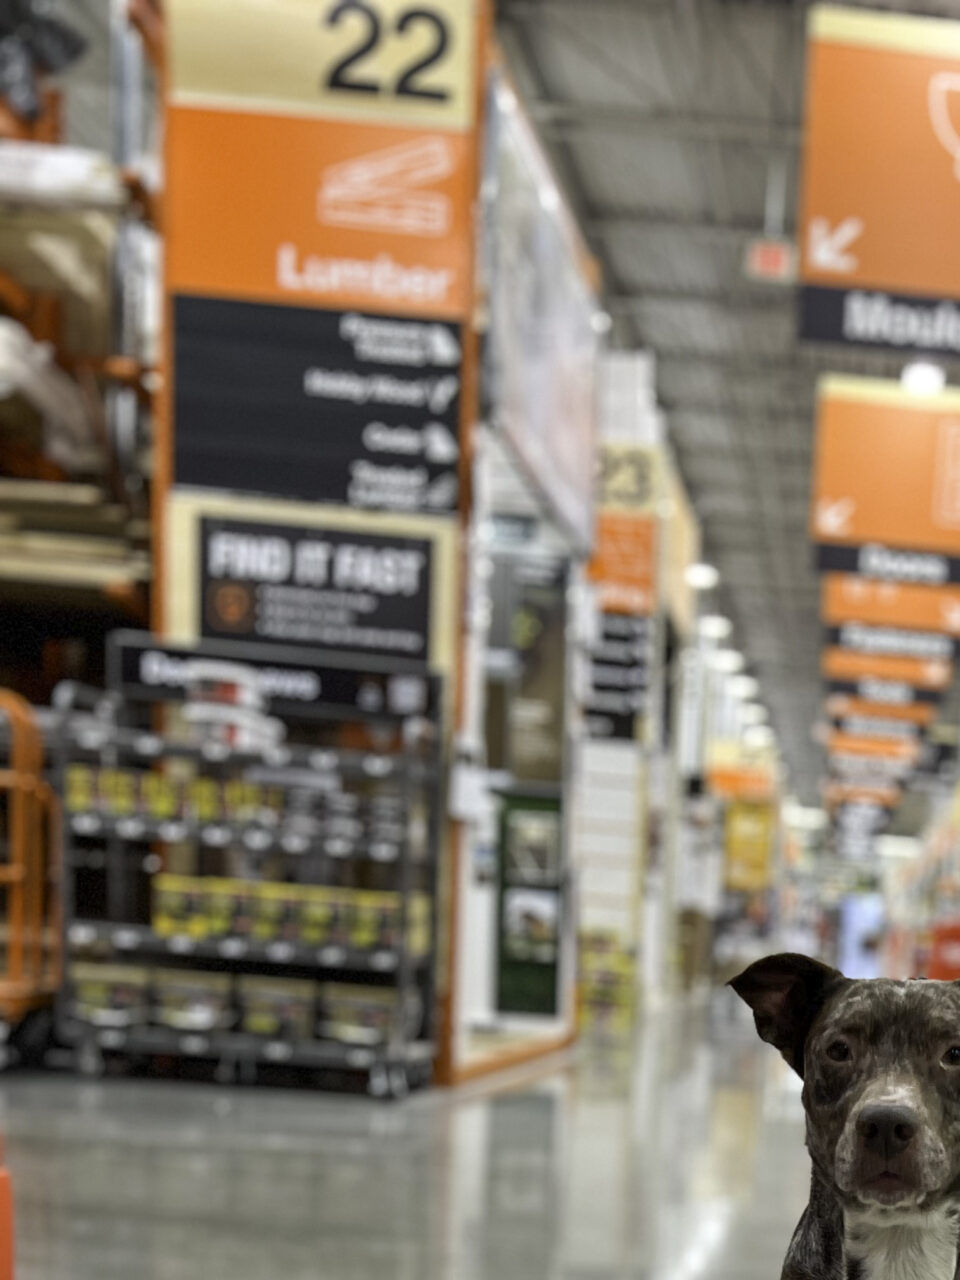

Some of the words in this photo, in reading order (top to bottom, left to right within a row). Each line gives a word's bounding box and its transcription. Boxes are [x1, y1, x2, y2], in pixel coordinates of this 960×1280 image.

[323, 0, 454, 103] 22
[276, 245, 455, 303] Lumber
[208, 531, 291, 583] FIND
[294, 539, 332, 588] IT
[333, 545, 426, 597] FAST
